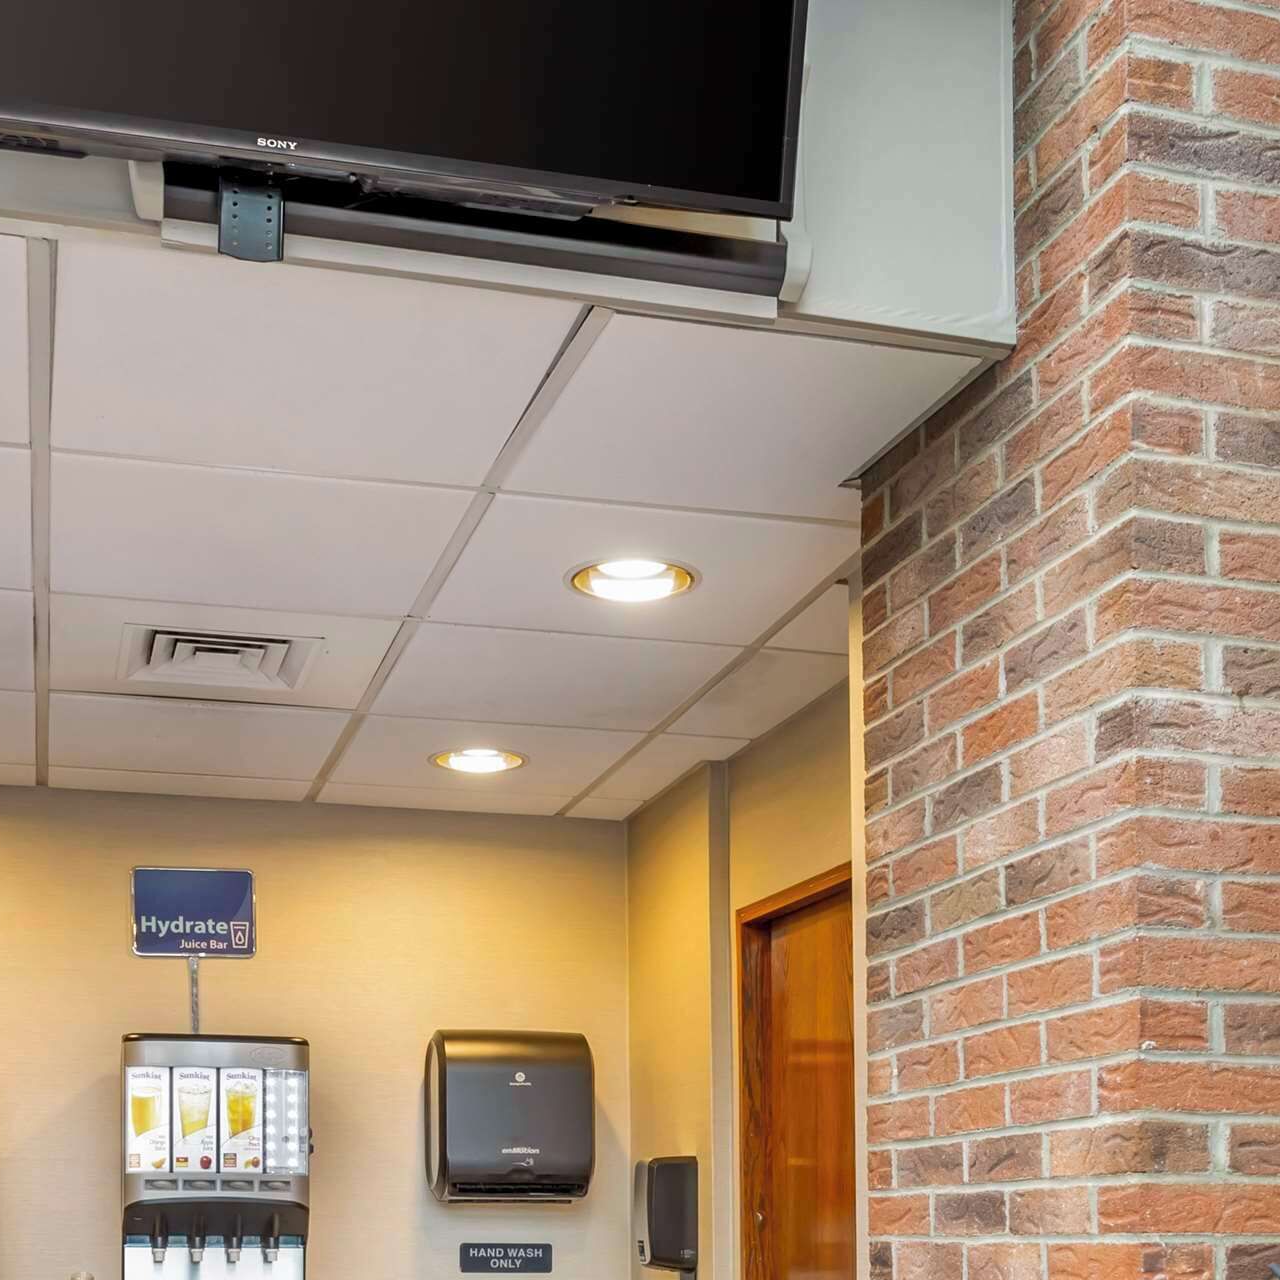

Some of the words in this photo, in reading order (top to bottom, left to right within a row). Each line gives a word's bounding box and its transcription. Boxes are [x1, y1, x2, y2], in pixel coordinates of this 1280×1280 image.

[256, 137, 298, 150] SONY
[140, 915, 229, 938] Hydrate
[179, 939, 208, 950] Juice
[209, 939, 229, 950] Bar
[179, 1071, 210, 1081] Sunkist
[226, 1071, 257, 1081] Sunkist
[469, 1247, 505, 1258] HAND
[506, 1247, 543, 1258] WASH
[489, 1258, 522, 1269] ONLY
